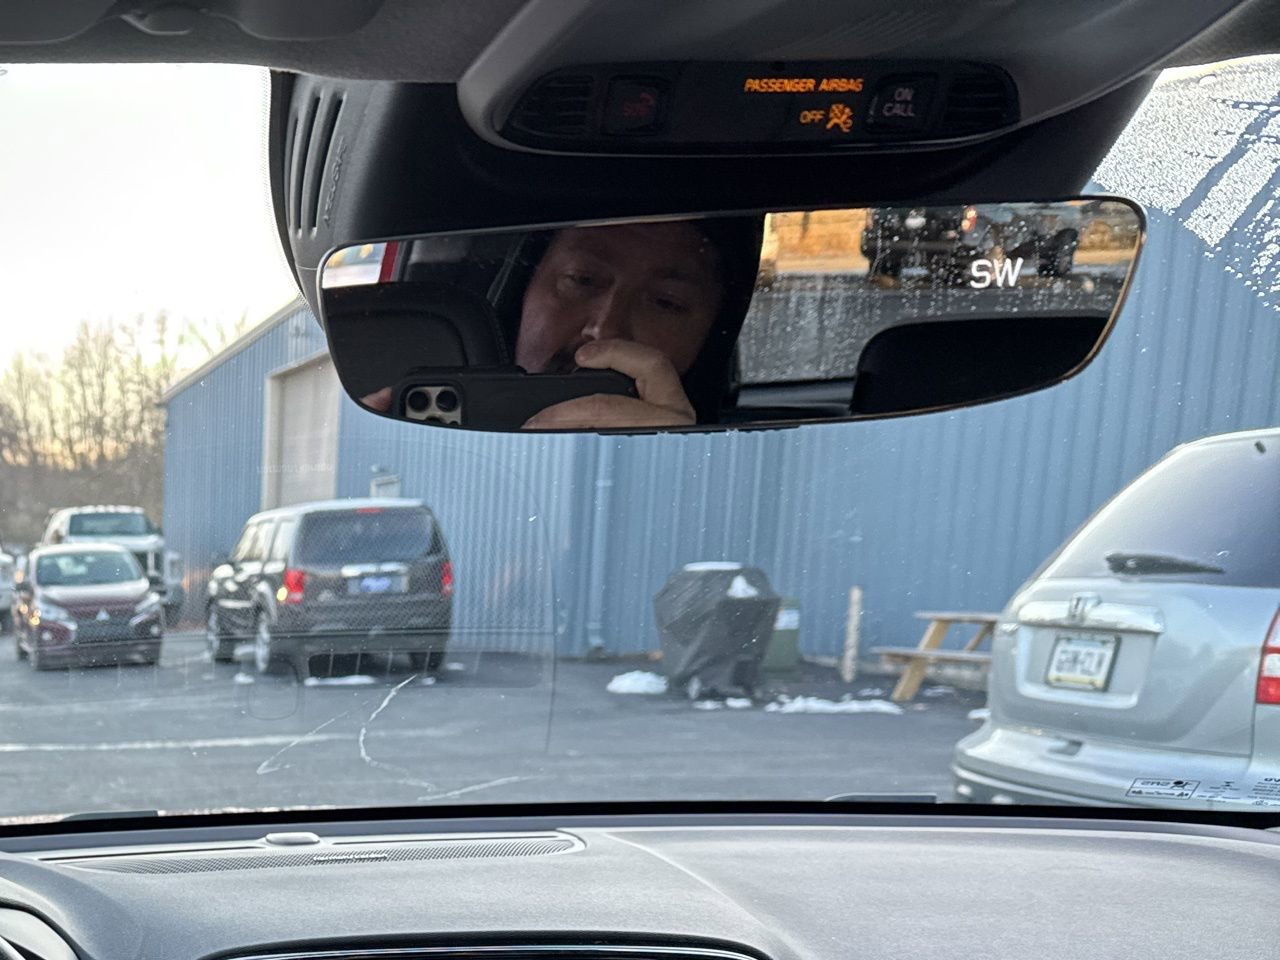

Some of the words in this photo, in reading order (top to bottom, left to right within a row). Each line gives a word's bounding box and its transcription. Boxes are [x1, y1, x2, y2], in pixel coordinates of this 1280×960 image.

[744, 78, 815, 93] PASSENGER
[819, 78, 864, 92] AIRBAG
[799, 110, 825, 123] OFF
[882, 103, 915, 117] CALL
[969, 256, 1024, 289] SW
